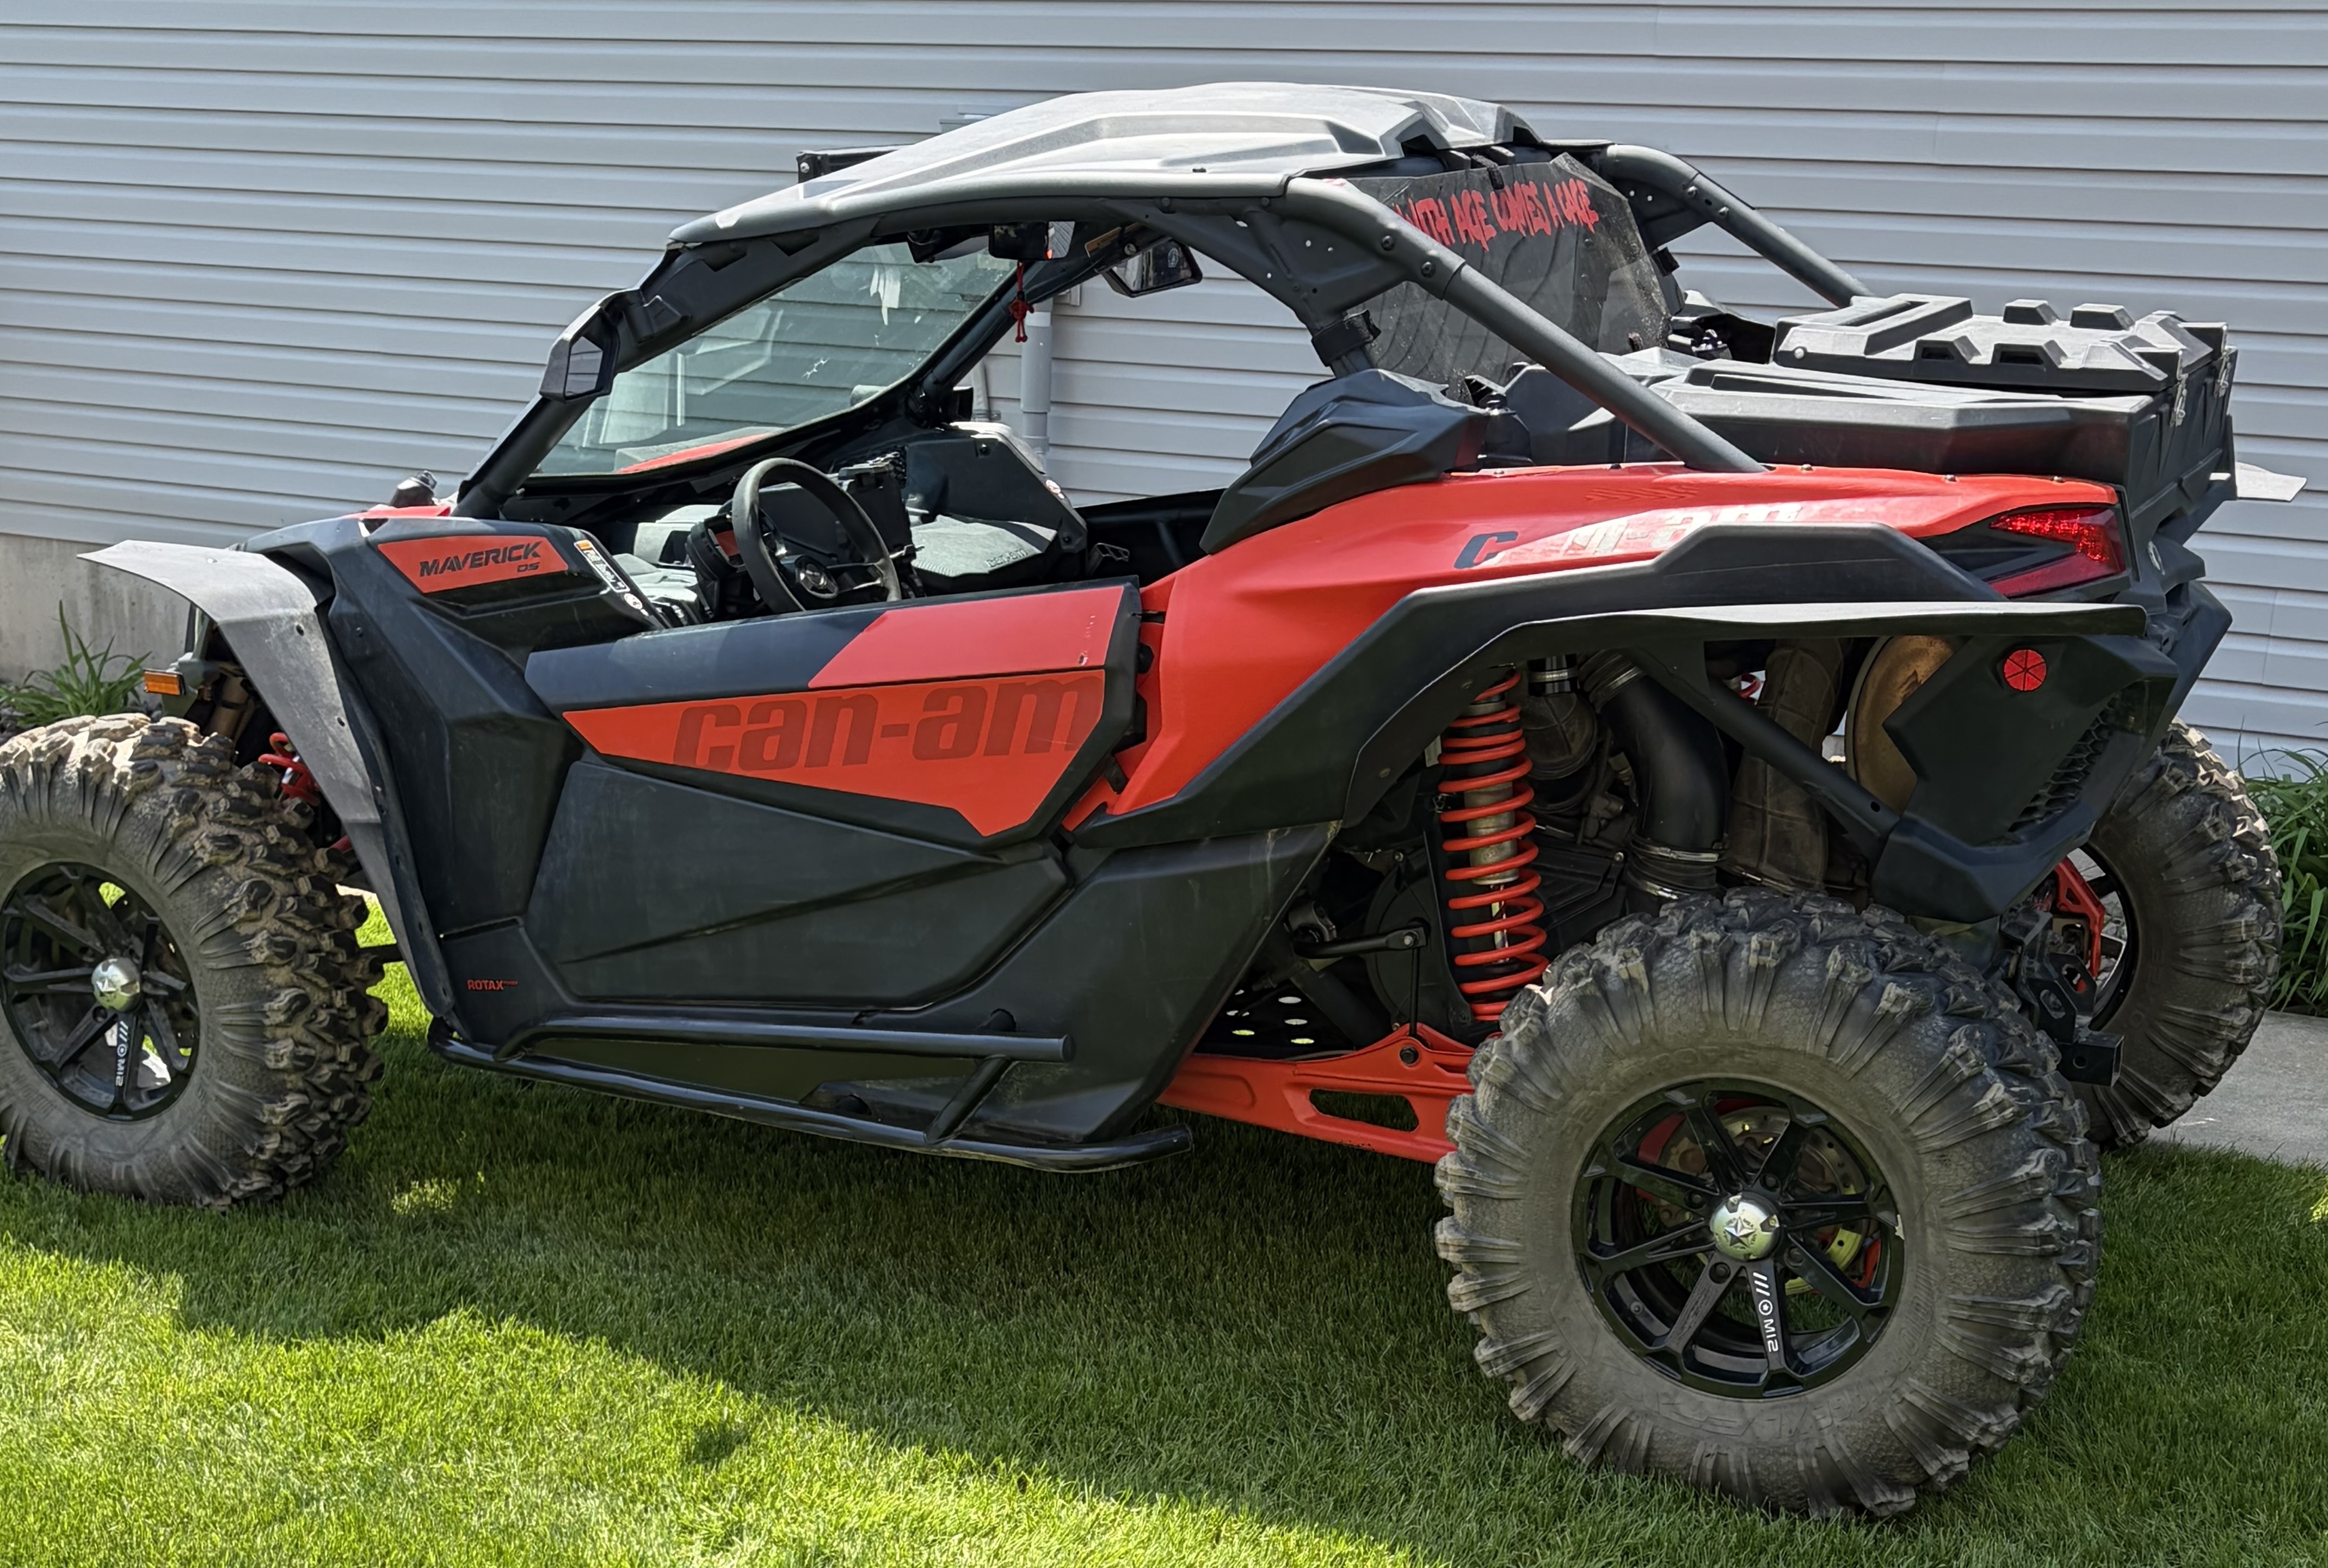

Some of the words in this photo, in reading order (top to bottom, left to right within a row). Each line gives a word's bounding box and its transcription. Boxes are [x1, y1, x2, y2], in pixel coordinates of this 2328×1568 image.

[1451, 189, 1496, 252] AGE
[1490, 180, 1551, 237] COMES
[1543, 182, 1565, 229] A
[1555, 178, 1599, 234] CAGE
[420, 541, 542, 577] MAVERICK
[1454, 504, 1803, 568] cn-am
[517, 562, 540, 572] DS
[673, 676, 1103, 771] can-am
[467, 979, 504, 990] ROTAX
